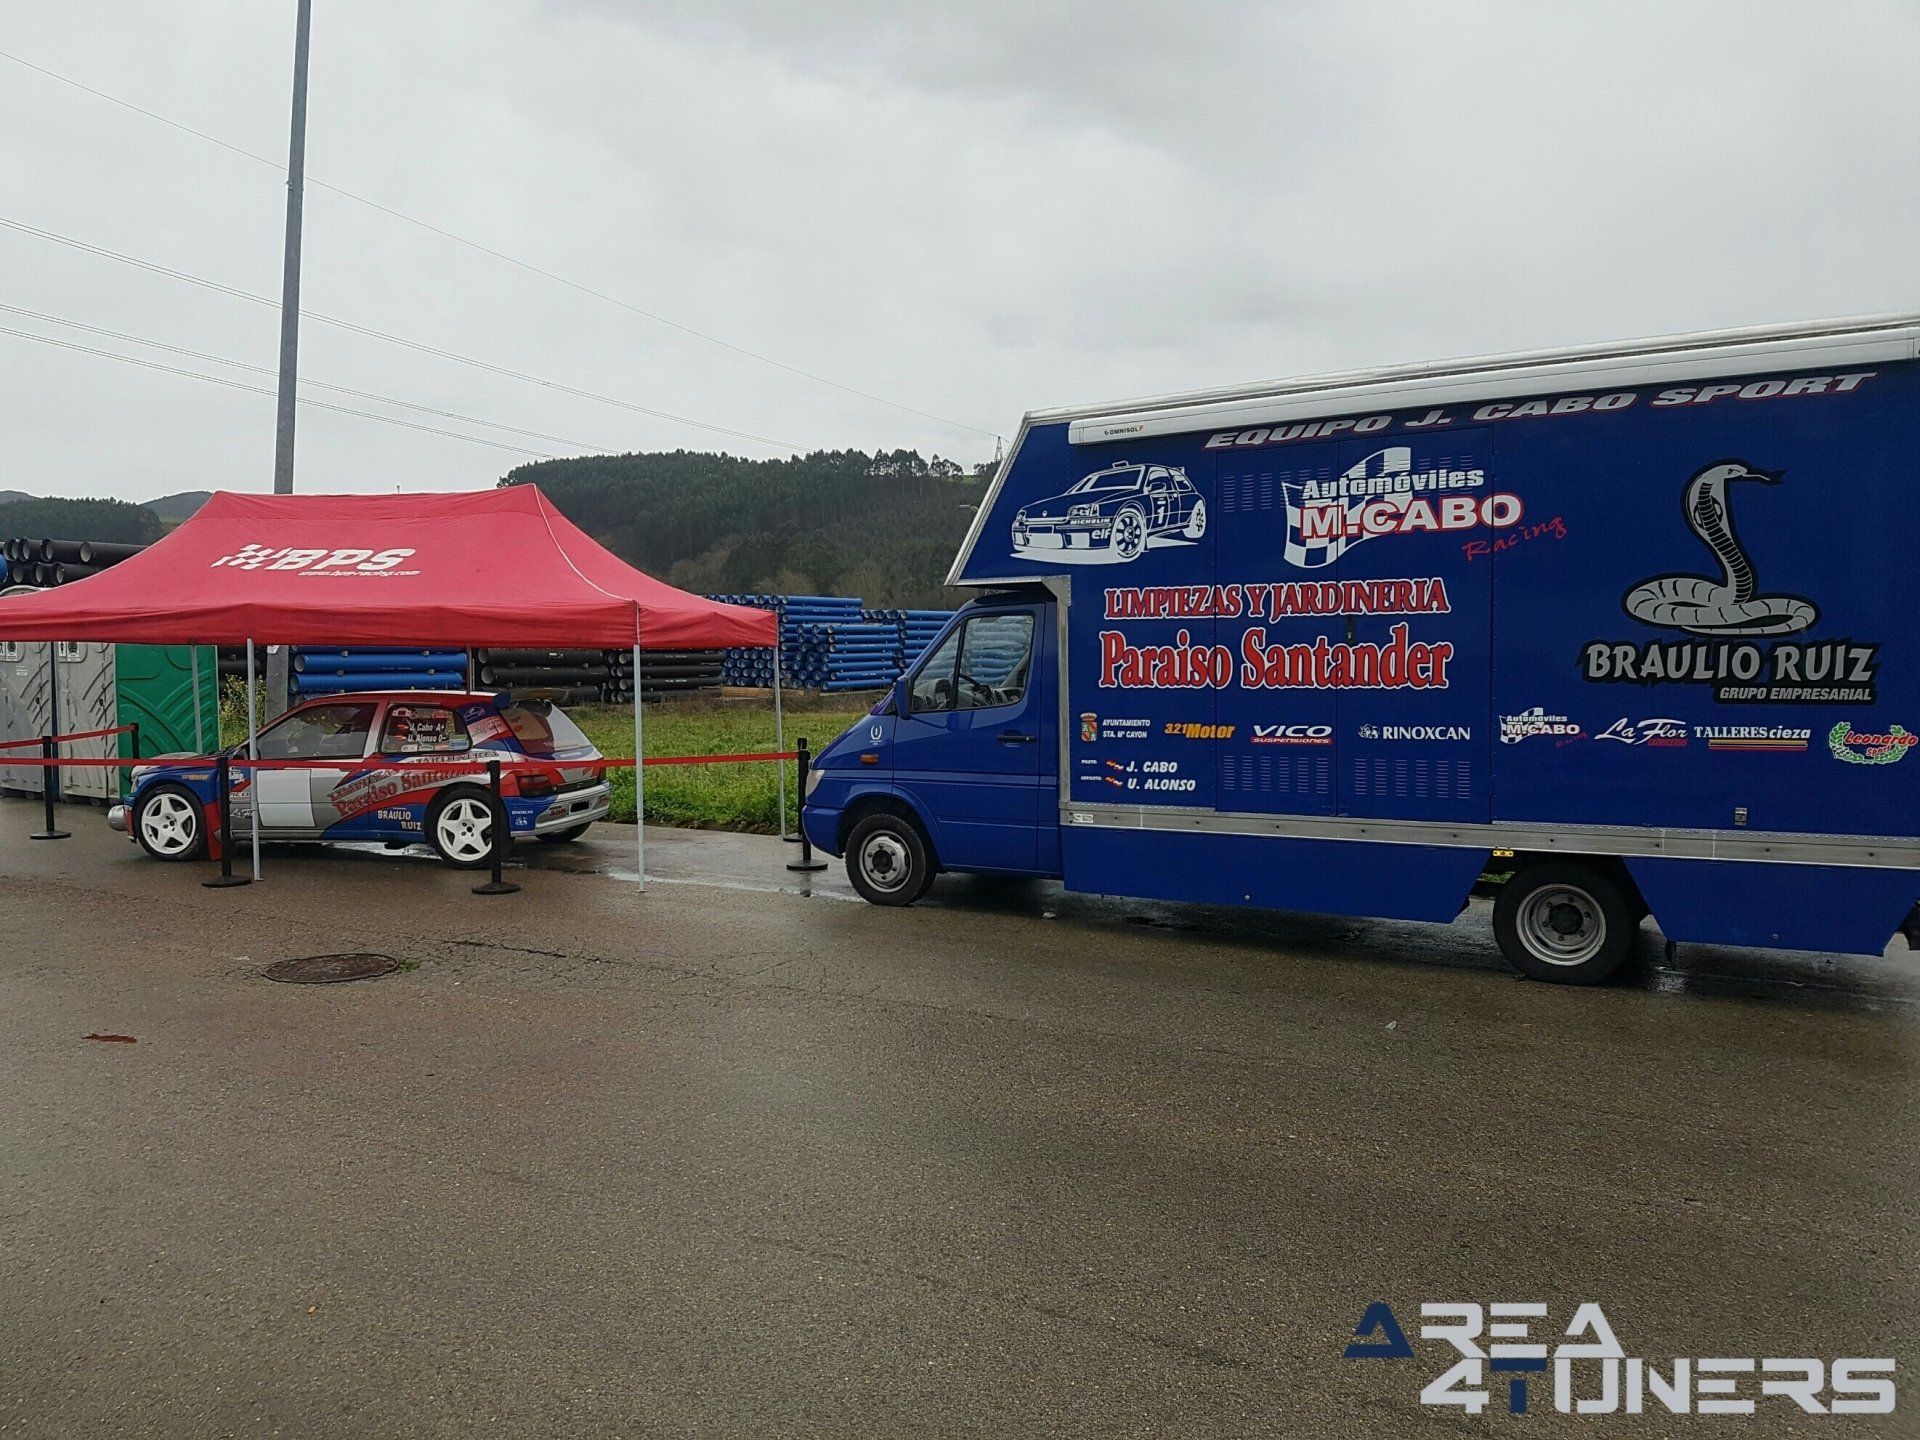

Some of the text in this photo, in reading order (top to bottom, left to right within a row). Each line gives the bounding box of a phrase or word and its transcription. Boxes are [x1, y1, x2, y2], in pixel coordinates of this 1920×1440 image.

[1202, 372, 1878, 449] EQUIPO J. CABO SPORT
[1109, 426, 1138, 435] OMNISOL
[1302, 469, 1484, 499] Automóviles
[1157, 506, 1165, 524] 1
[1301, 492, 1524, 539] M.CABO
[1091, 529, 1111, 540] elf
[1461, 516, 1567, 561] Racing
[266, 548, 416, 570] BPS
[1104, 577, 1451, 623] LIMPIEZAS Y JARDINERIA
[1099, 622, 1454, 689] Paraiso Santander
[1586, 643, 1874, 682] BRAULIO RUIZ
[1719, 687, 1872, 700] GRUPO EMPRESARIAL
[417, 723, 433, 732] Cabo
[1102, 719, 1150, 727] AYUNTAMIENTO
[1506, 724, 1580, 735] M.CABO
[1126, 731, 1147, 739] CAYON
[1164, 723, 1235, 739] 321Motor
[1253, 725, 1333, 737] VICO
[1382, 726, 1471, 740] RINOXCAN
[1594, 718, 1688, 745] La Flor
[1694, 725, 1811, 739] TALLERES cieza
[1843, 731, 1919, 747] Leonardo
[1126, 761, 1178, 773] J. CABO
[1127, 778, 1196, 791] U. ALONSO
[377, 810, 411, 820] BRAULIO
[400, 821, 422, 831] RUIZ
